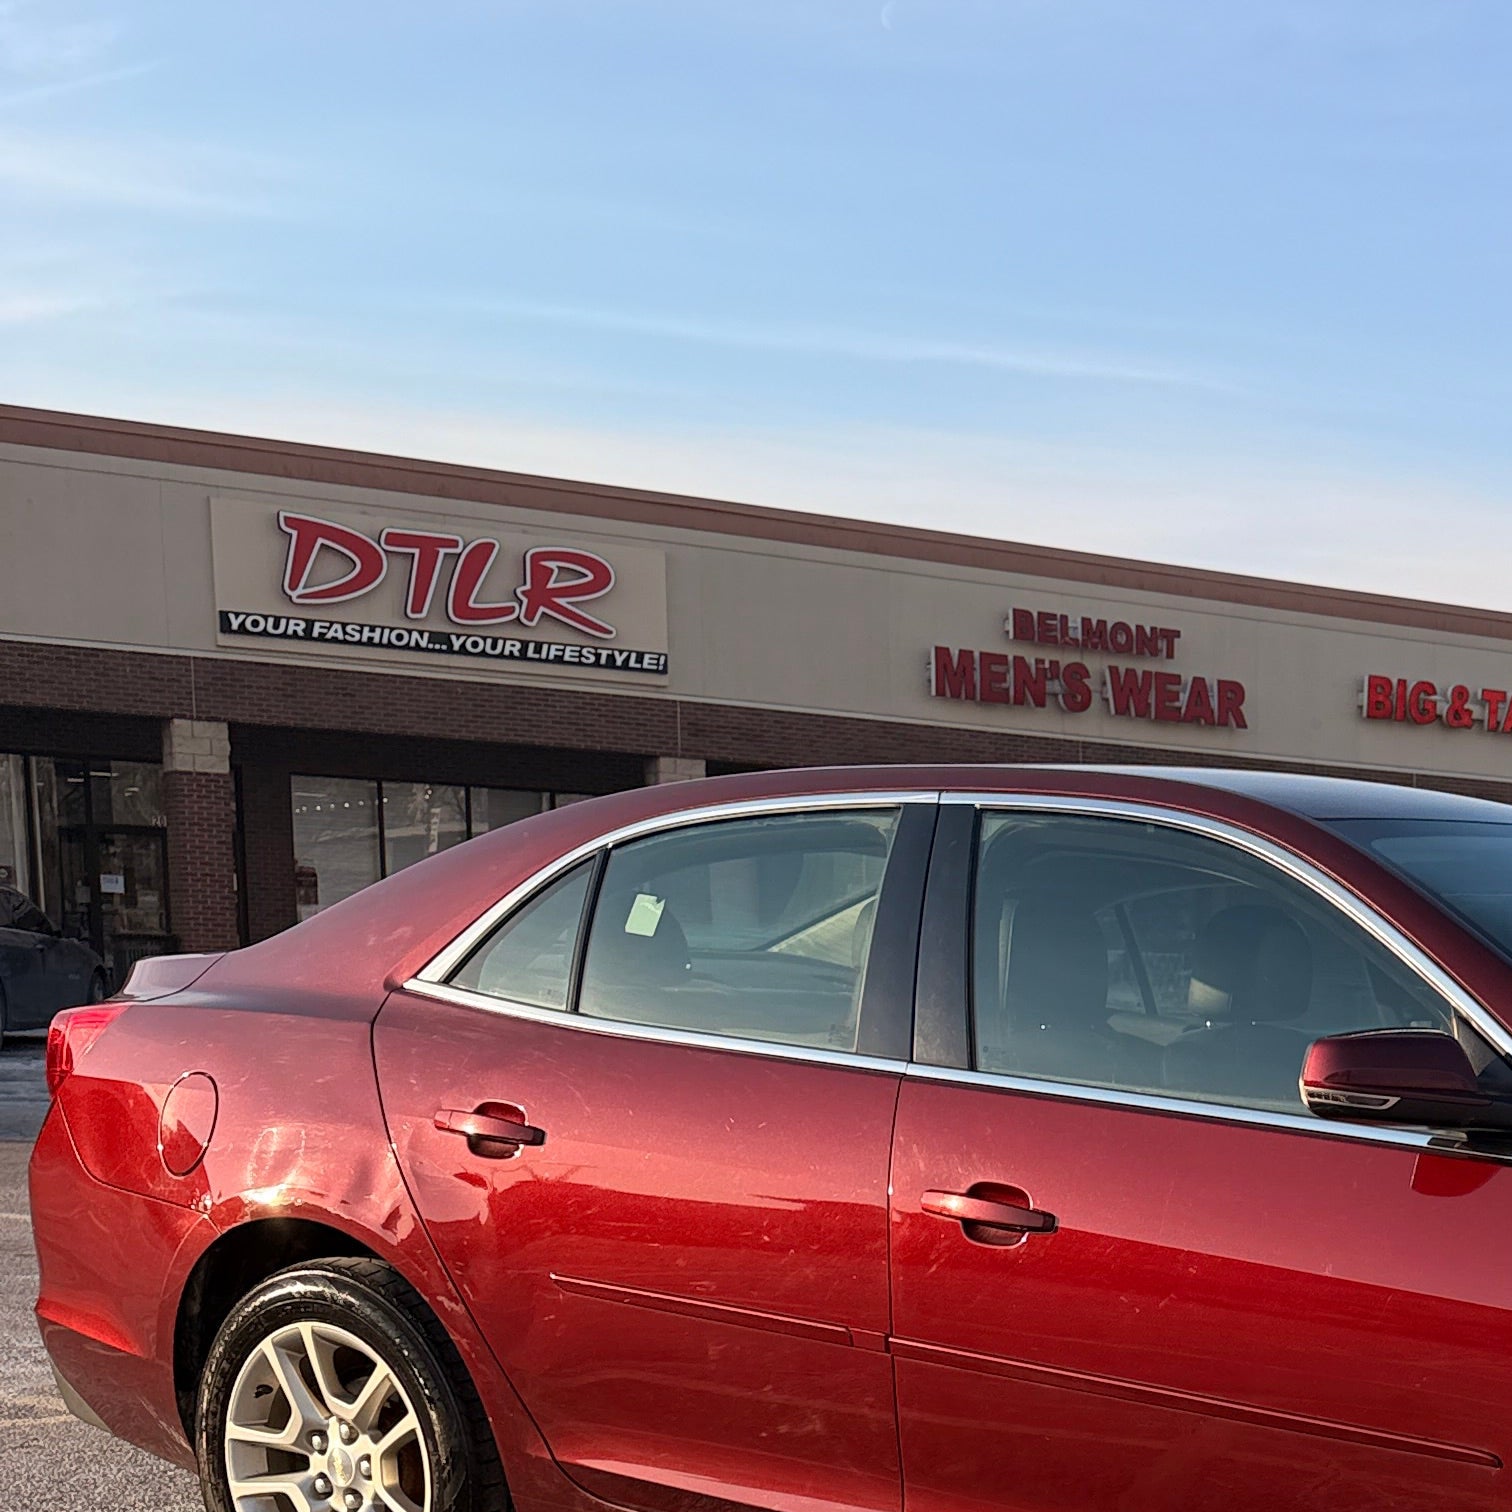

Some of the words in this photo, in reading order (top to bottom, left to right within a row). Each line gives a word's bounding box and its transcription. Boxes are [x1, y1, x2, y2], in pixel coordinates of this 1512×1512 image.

[277, 510, 616, 639] DTLR
[227, 612, 307, 637] YOUR
[526, 642, 667, 671] LIFESTYLE!
[1008, 607, 1181, 660] BELMONT
[931, 646, 1092, 713] MEN'S
[1107, 665, 1248, 729] WEAR
[1363, 674, 1438, 725] BIG
[1445, 684, 1473, 730] &
